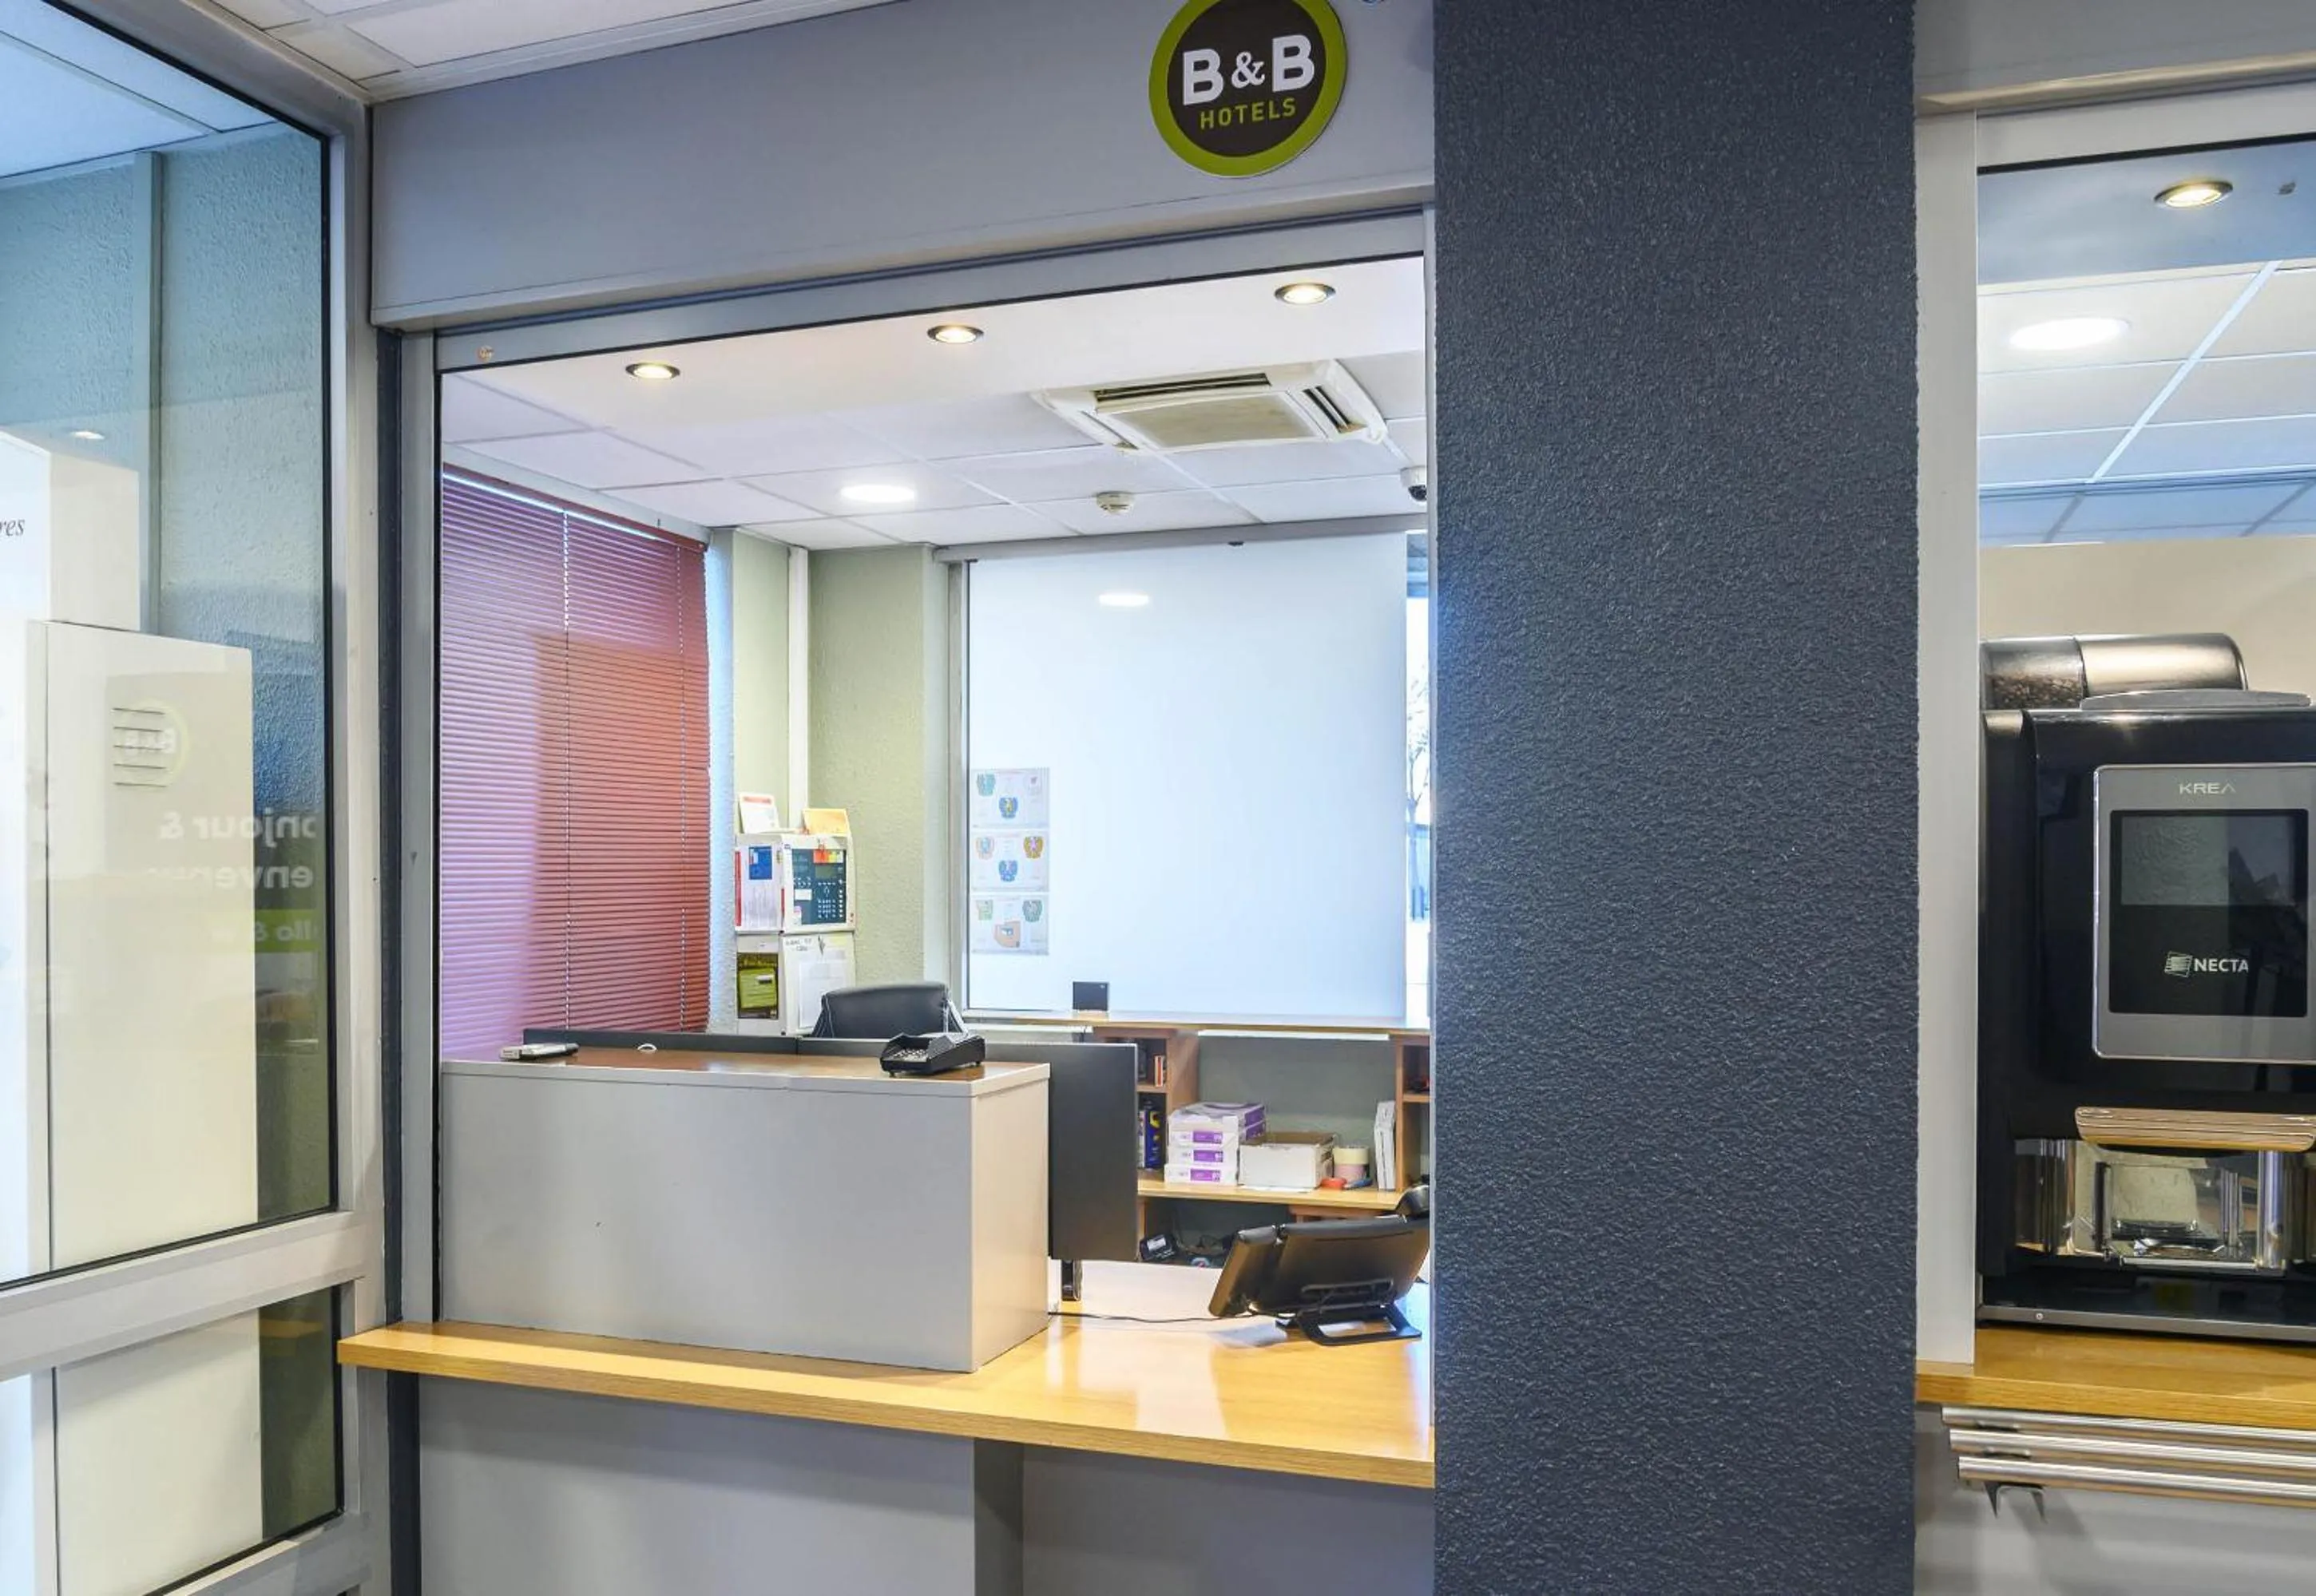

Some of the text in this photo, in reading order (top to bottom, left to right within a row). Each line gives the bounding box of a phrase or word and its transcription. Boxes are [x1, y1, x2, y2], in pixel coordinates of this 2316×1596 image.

[1200, 97, 1296, 129] HOTELS
[2179, 782, 2236, 794] KREA
[2194, 957, 2249, 972] NECTA
